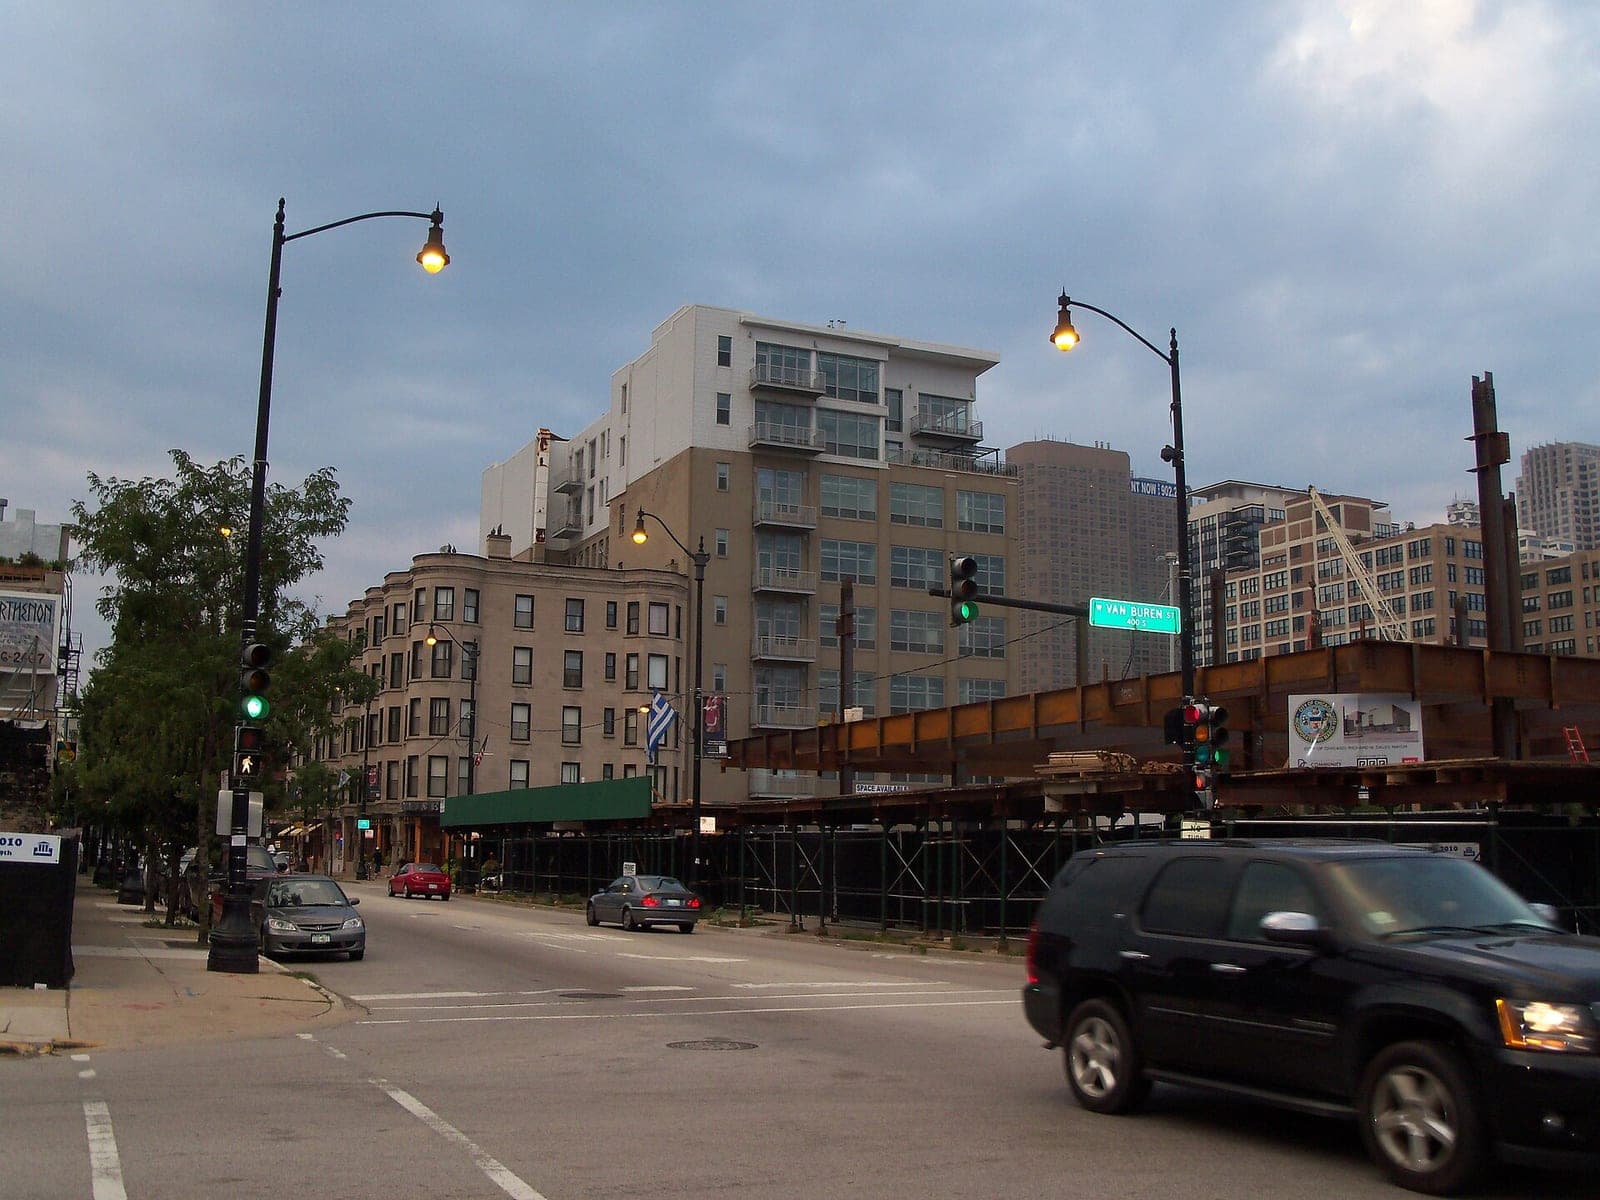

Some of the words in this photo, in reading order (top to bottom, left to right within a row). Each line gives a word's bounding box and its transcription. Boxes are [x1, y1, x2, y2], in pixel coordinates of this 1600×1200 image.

[1141, 481, 1157, 495] NOW
[1106, 603, 1126, 615] VAN
[1131, 606, 1163, 619] BUREN
[1126, 618, 1140, 626] 400
[856, 784, 876, 792] SPACE
